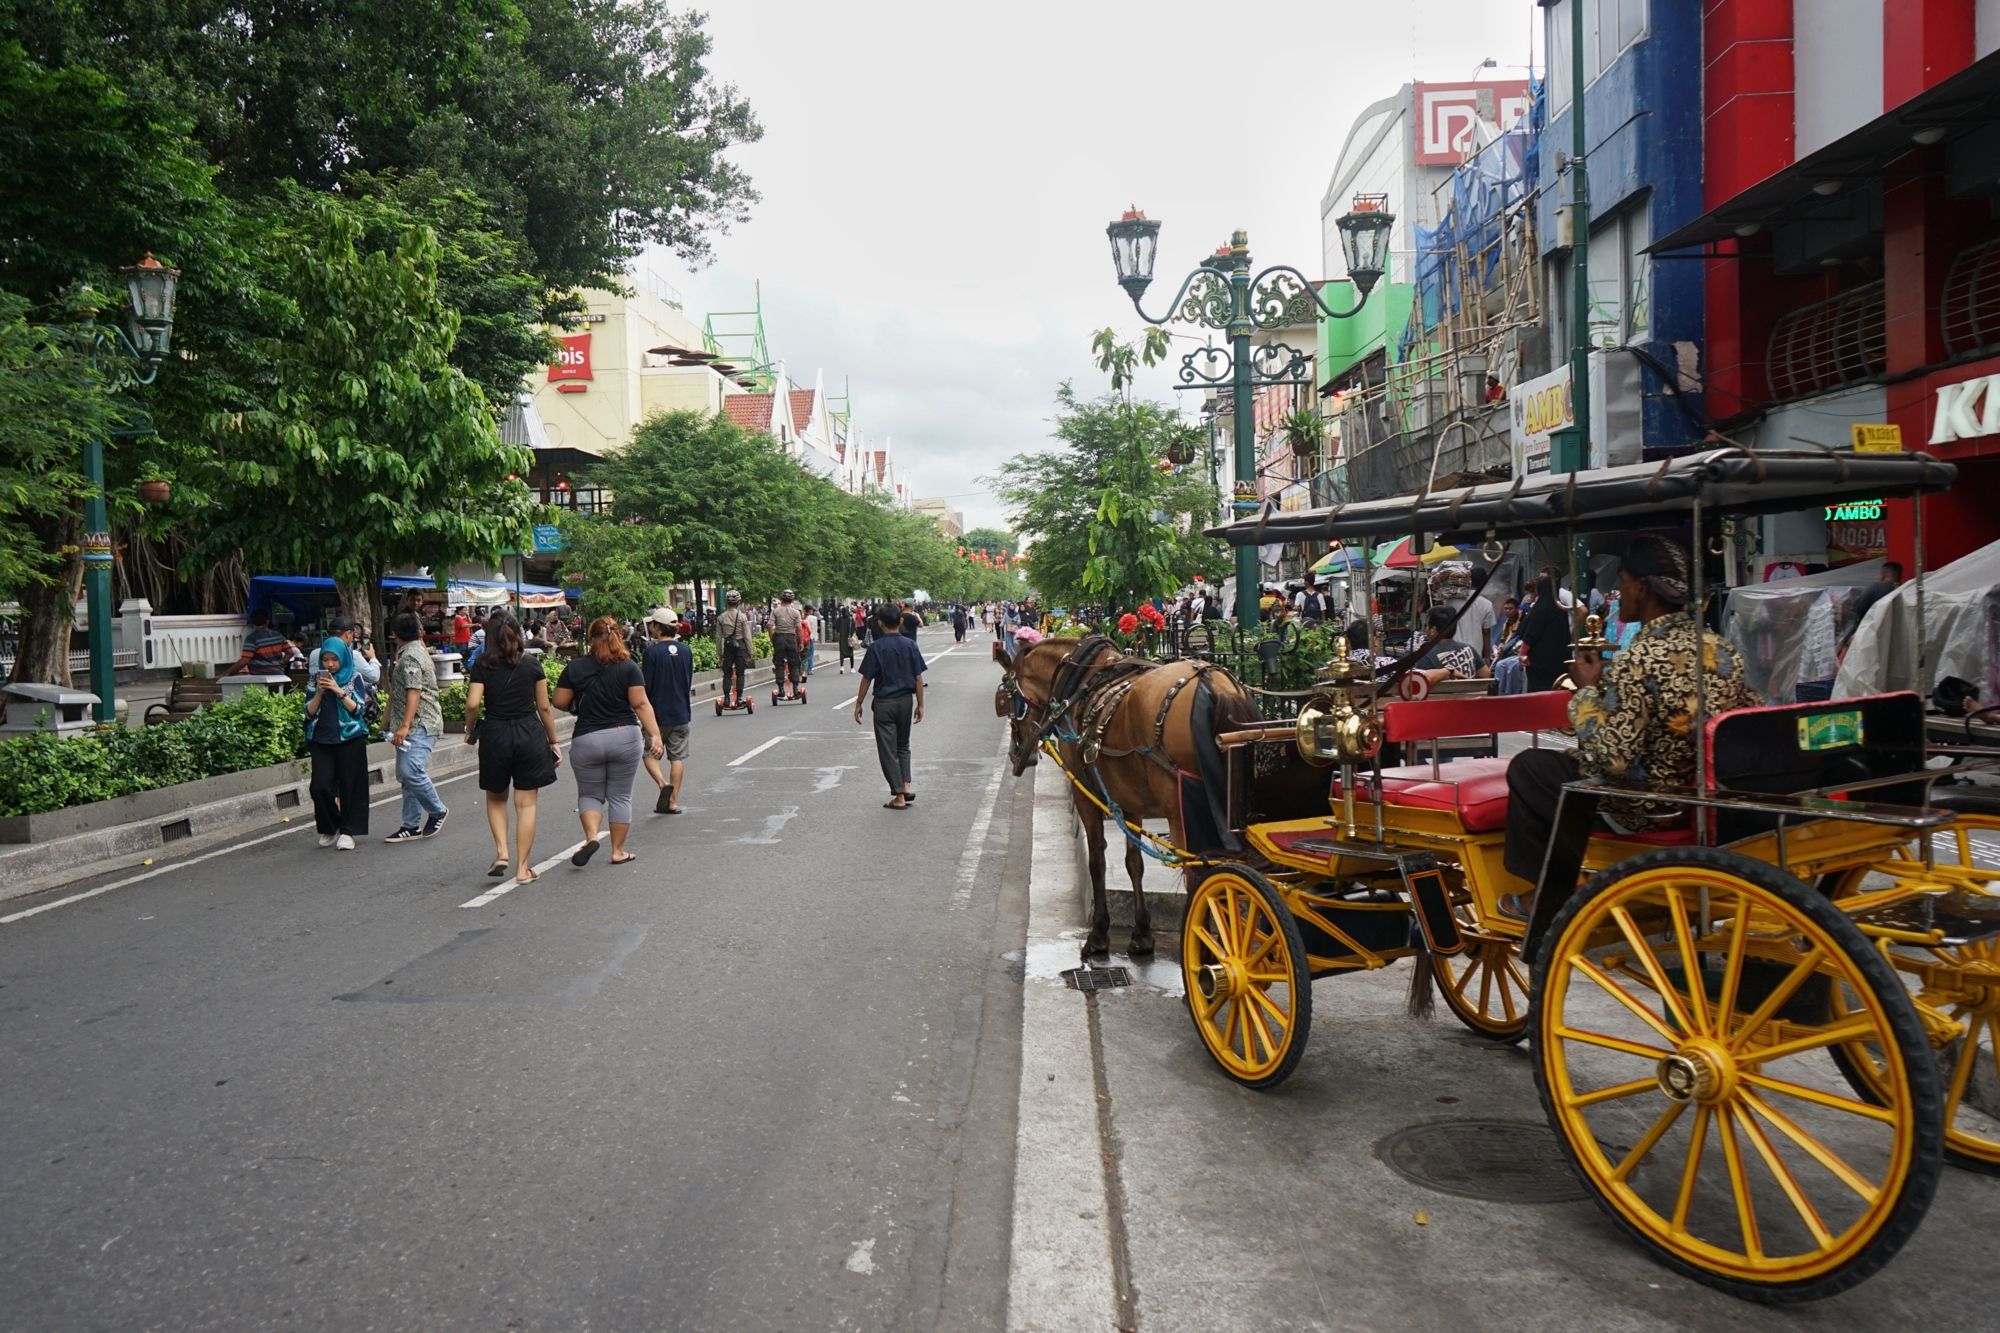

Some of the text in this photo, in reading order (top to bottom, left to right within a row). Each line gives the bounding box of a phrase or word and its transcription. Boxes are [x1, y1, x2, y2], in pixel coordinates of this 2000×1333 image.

[557, 346, 585, 365] bis
[1833, 506, 1881, 521] AMBO
[1839, 527, 1886, 547] JOGJA
